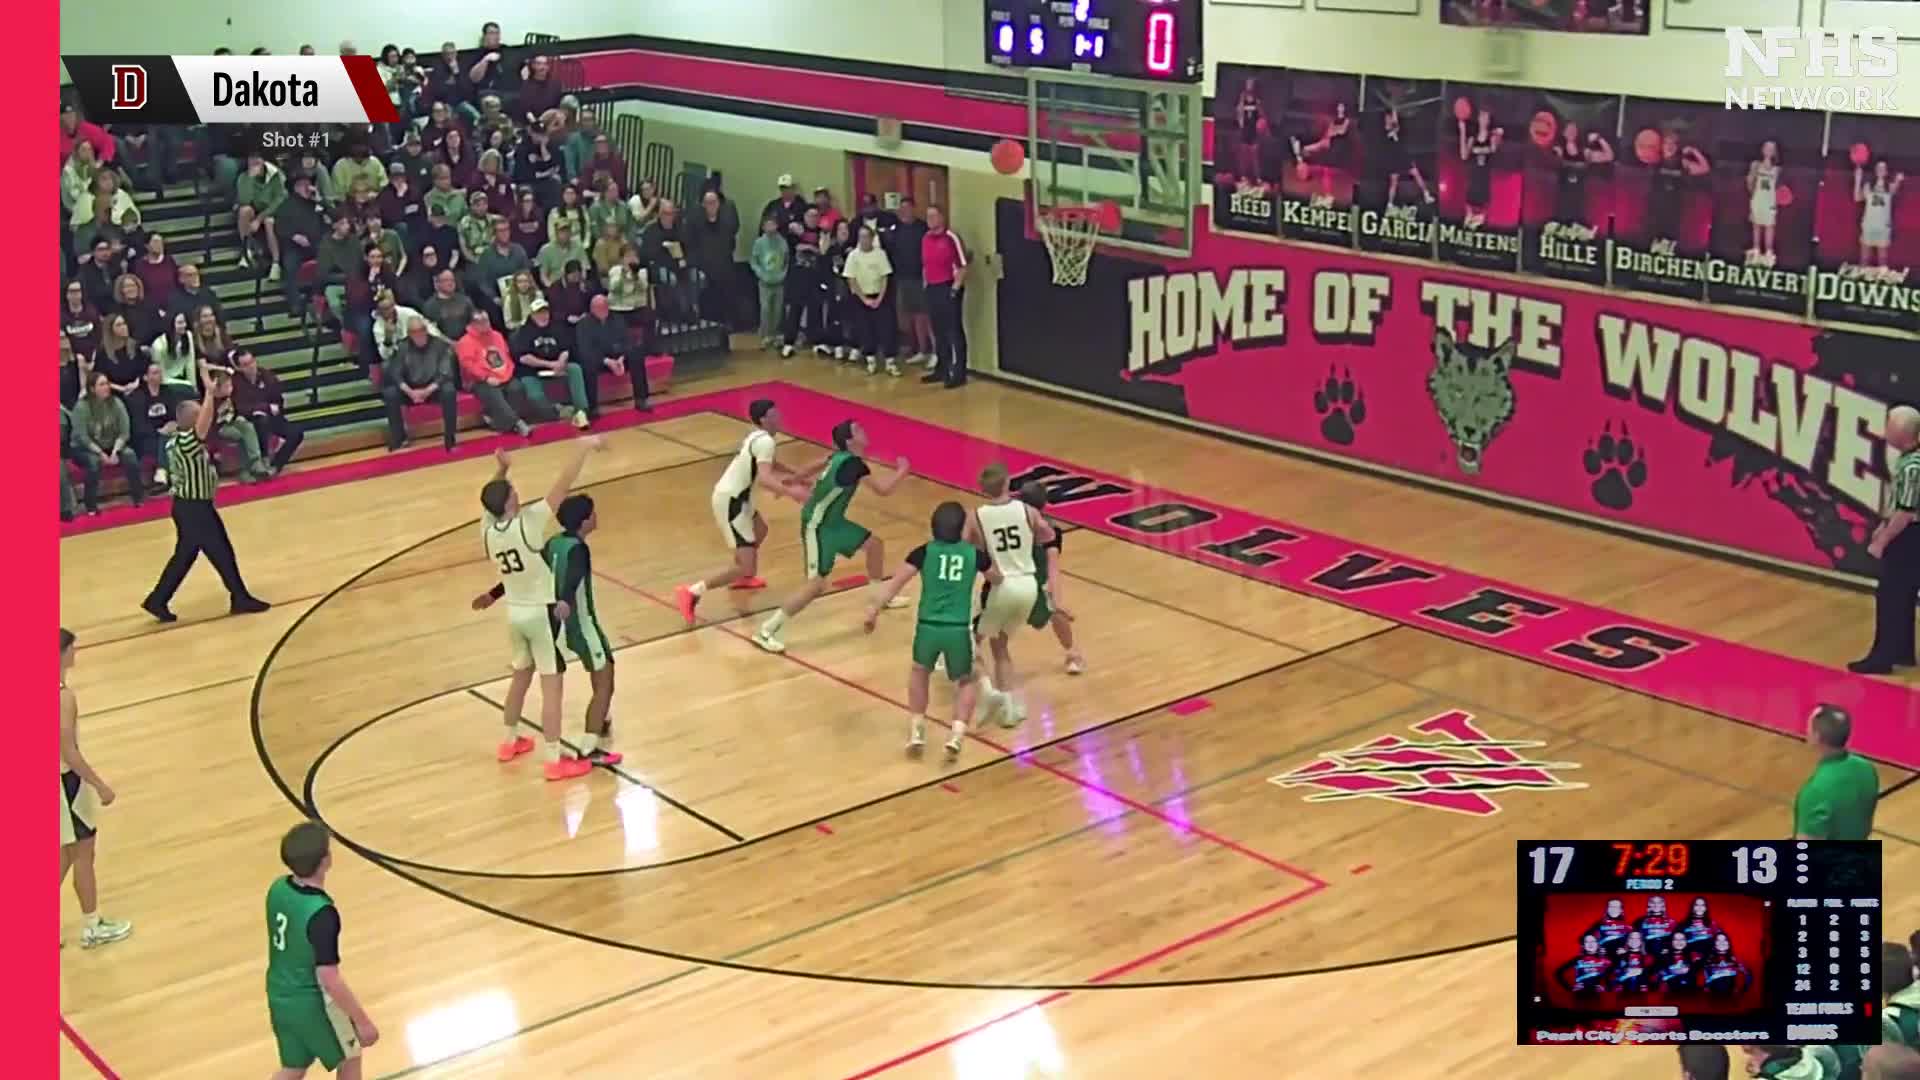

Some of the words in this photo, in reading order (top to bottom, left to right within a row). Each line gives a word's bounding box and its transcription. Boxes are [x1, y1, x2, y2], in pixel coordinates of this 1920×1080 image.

[1146, 12, 1173, 71] 0
[1230, 193, 1271, 217] REED
[1440, 225, 1520, 253] MARTENS
[1540, 234, 1598, 265] HILLE
[1816, 272, 1920, 312] DOWNS
[1127, 268, 1286, 373] HOME
[1312, 273, 1391, 335] OF
[1420, 281, 1563, 368] THE
[1600, 313, 1893, 513] WOLVE
[993, 526, 1022, 552] 35
[495, 548, 525, 574] 33
[938, 554, 964, 581] 12
[1008, 465, 1699, 673] WOLVES
[273, 912, 288, 951] 3
